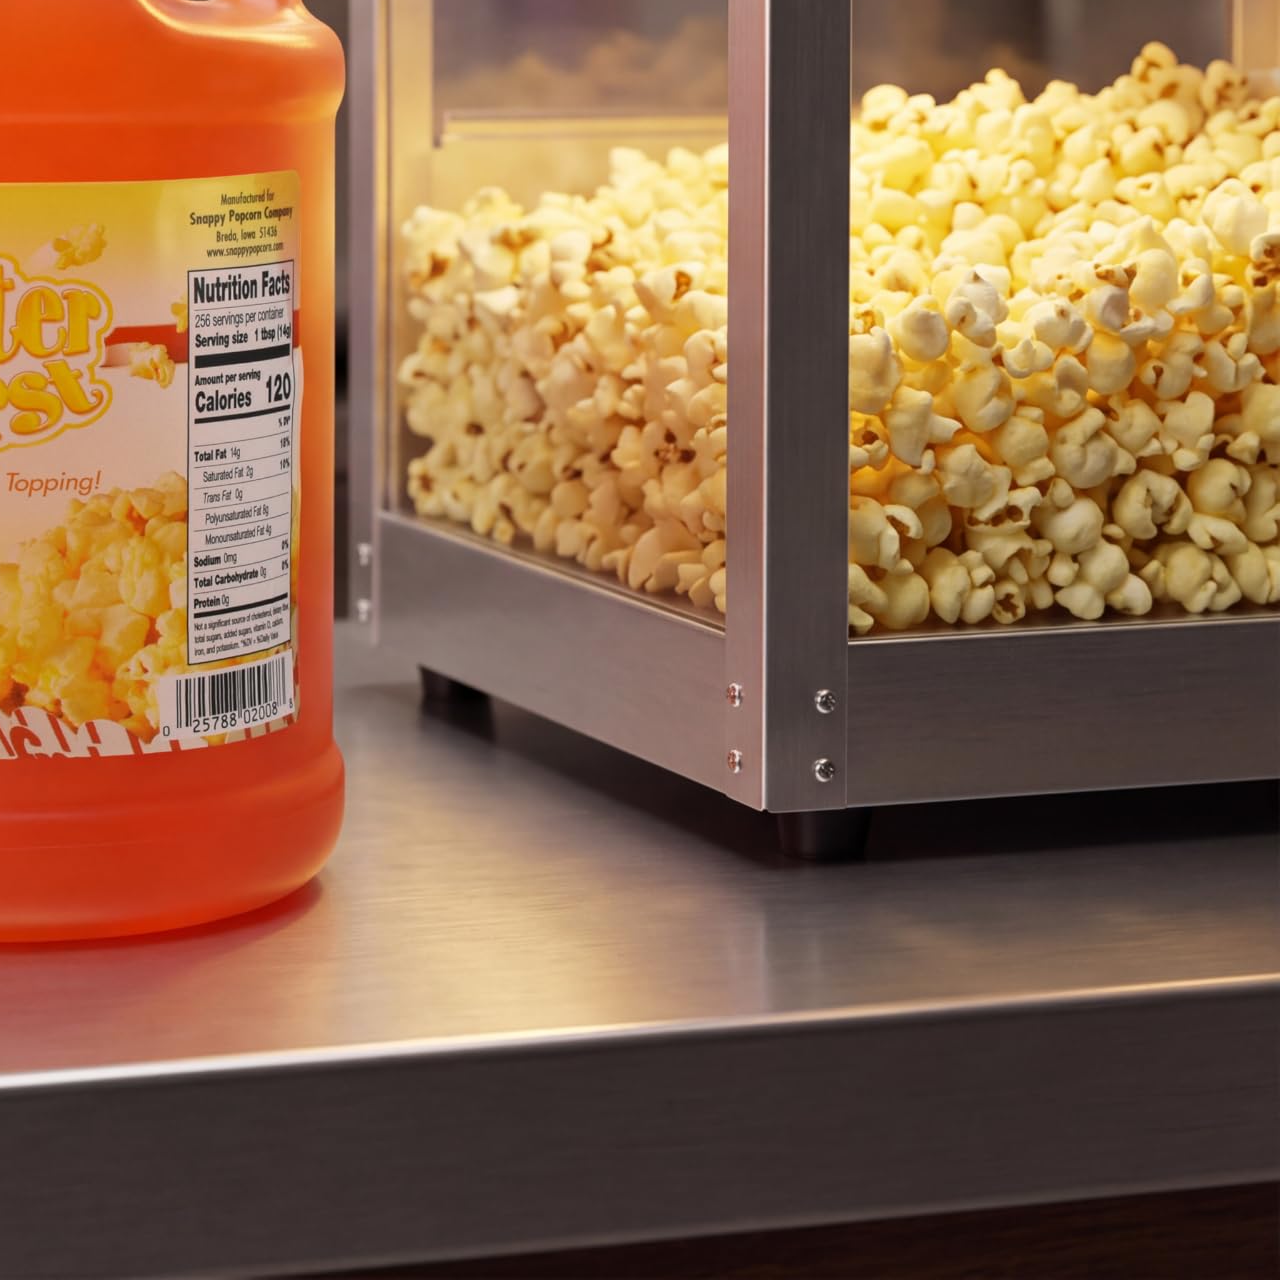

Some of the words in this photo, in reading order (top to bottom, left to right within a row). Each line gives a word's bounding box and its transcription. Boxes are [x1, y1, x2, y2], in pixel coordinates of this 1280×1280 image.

[221, 190, 265, 205] Manufactured
[267, 188, 275, 201] for
[190, 212, 226, 228] Snappy
[229, 209, 262, 225] Popcorn
[264, 206, 293, 221] Company
[241, 229, 256, 240] Iowa
[207, 241, 284, 258] www.snappypopcorn.com
[194, 274, 258, 304] Nutrition
[262, 270, 290, 297] Facts
[195, 314, 211, 328] 256
[213, 312, 243, 328] servings
[245, 311, 257, 326] per
[258, 306, 284, 321] container
[195, 333, 229, 348] Serving
[232, 330, 248, 344] size
[261, 326, 276, 342] tbsp
[195, 373, 223, 386] Amount
[225, 373, 237, 385] per
[239, 369, 261, 381] serving
[266, 372, 291, 403] 120
[195, 388, 252, 413] Calories
[194, 450, 213, 462] Total
[215, 448, 227, 460] Fat
[6, 470, 101, 496] Topping!
[203, 470, 233, 482] Saturated
[234, 467, 244, 478] Fat
[203, 492, 220, 504] Trans
[222, 489, 231, 501] Fat
[254, 505, 262, 517] Fat
[257, 526, 265, 536] Fat
[194, 555, 221, 567] Sodium
[194, 576, 213, 588] Total
[215, 568, 258, 585] Carbohydrate
[194, 597, 220, 609] Protein
[163, 725, 170, 736] 0
[193, 713, 237, 733] 25788
[244, 701, 278, 724] 02008
